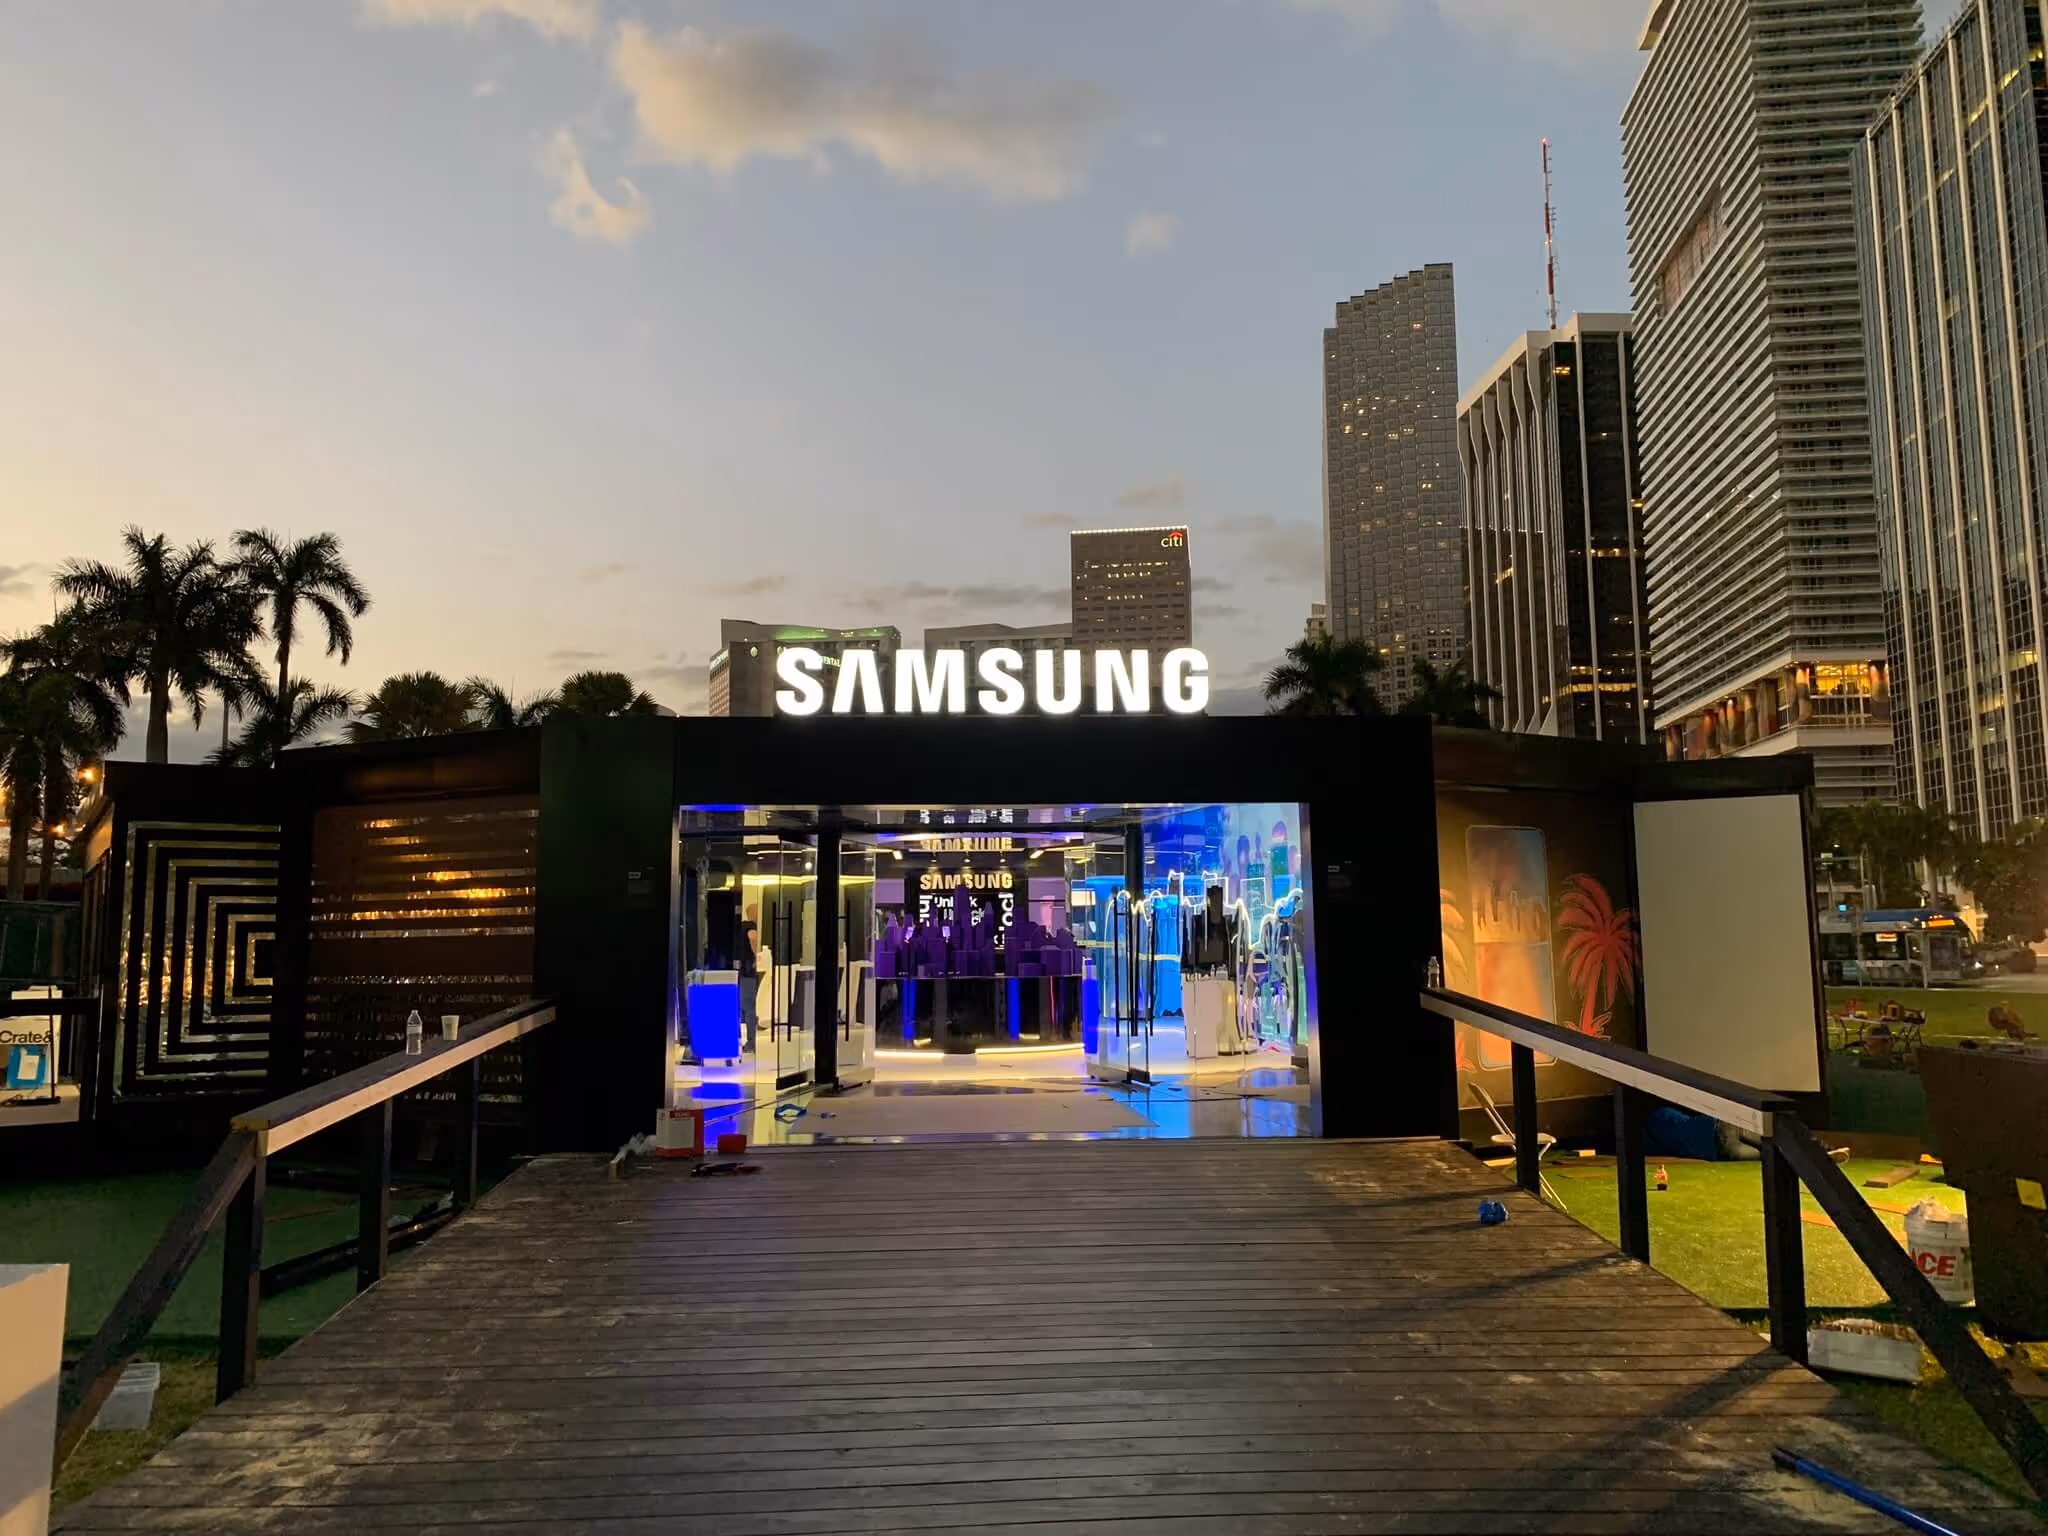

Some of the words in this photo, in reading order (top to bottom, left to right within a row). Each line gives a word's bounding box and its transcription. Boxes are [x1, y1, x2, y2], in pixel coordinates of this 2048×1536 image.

[1160, 531, 1183, 548] citi
[776, 647, 1209, 716] SAMSUNG
[920, 873, 1013, 890] SAMSUNG
